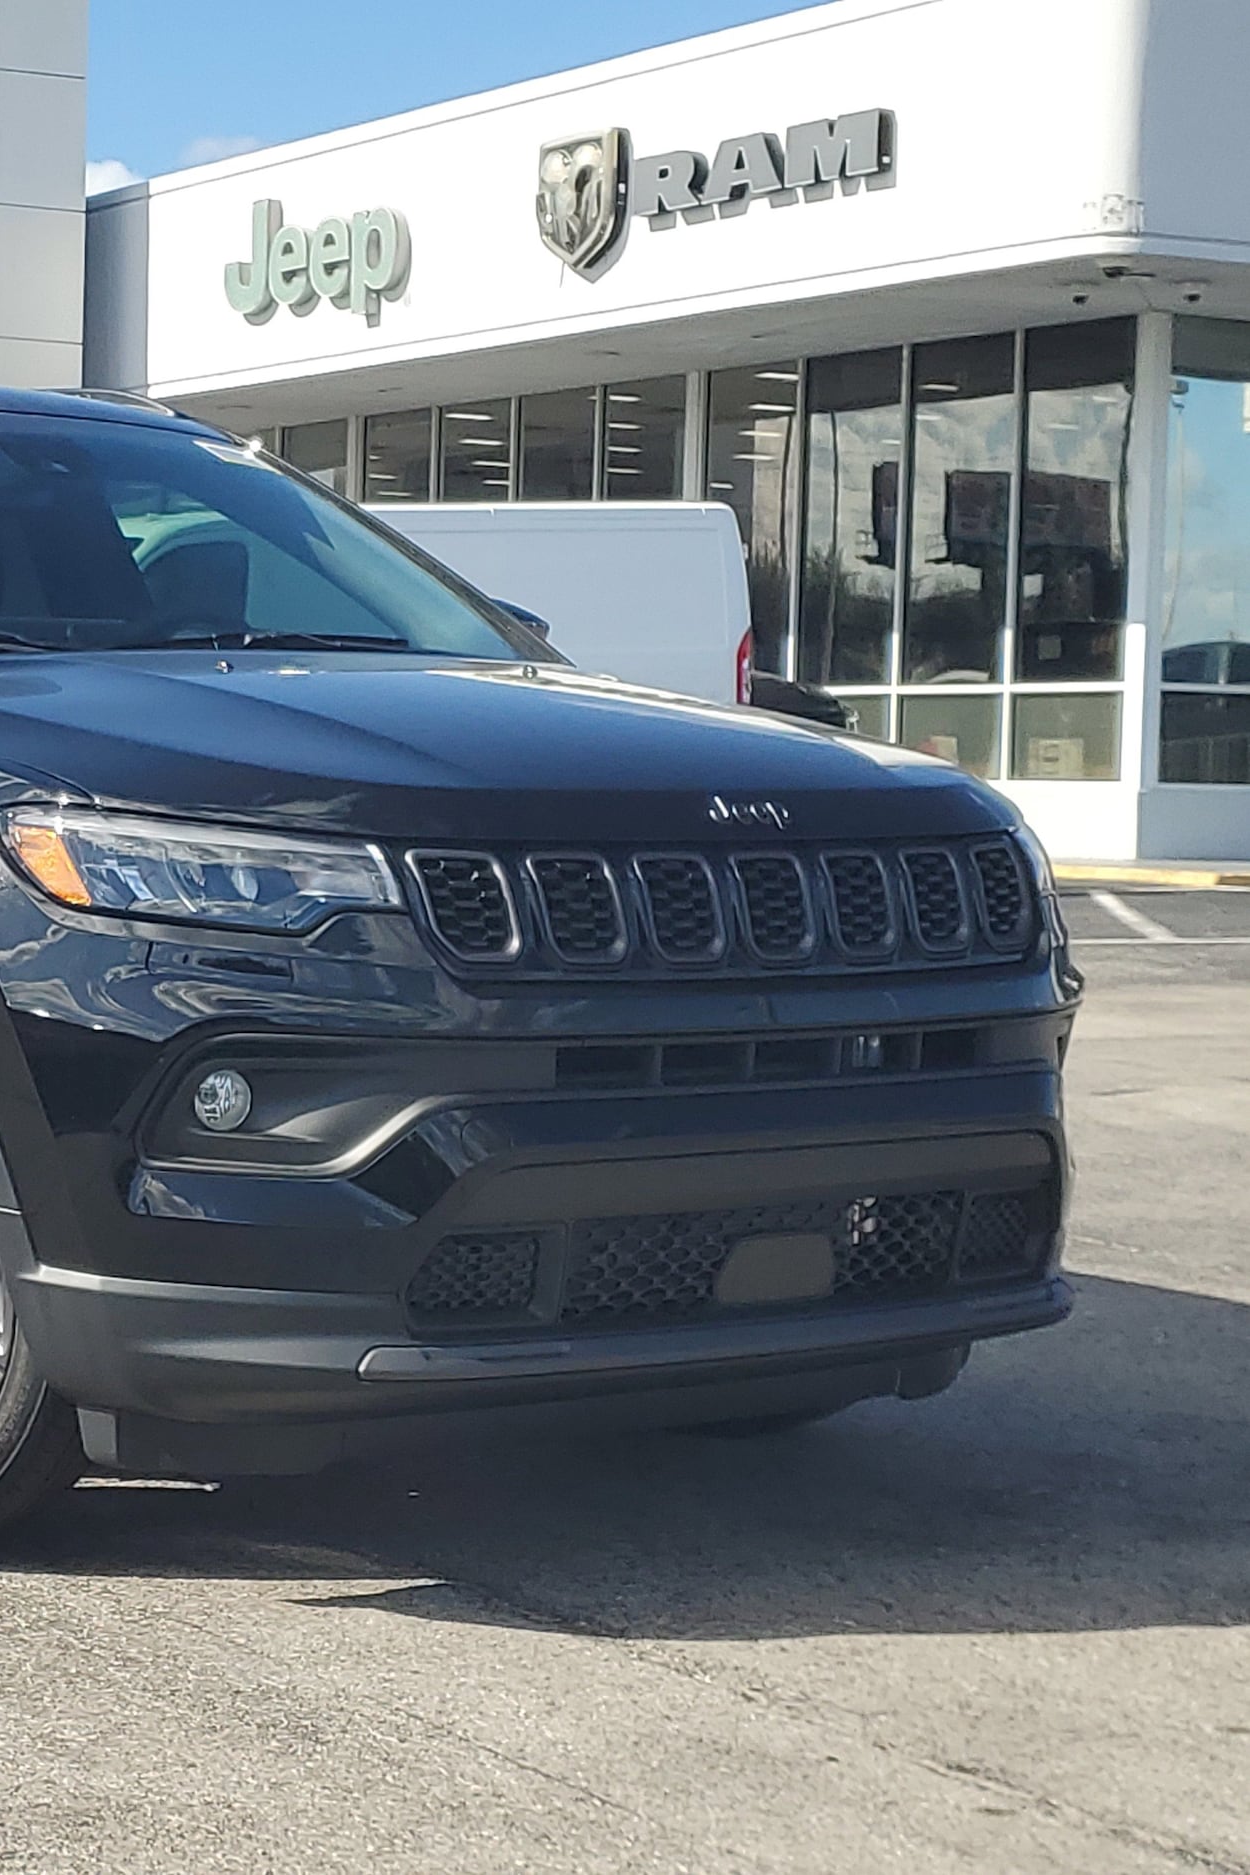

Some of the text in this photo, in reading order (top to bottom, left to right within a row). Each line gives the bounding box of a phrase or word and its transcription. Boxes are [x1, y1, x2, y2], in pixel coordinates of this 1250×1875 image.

[632, 108, 897, 230] RAM
[224, 198, 412, 328] Jeep
[709, 795, 790, 829] Jeep
